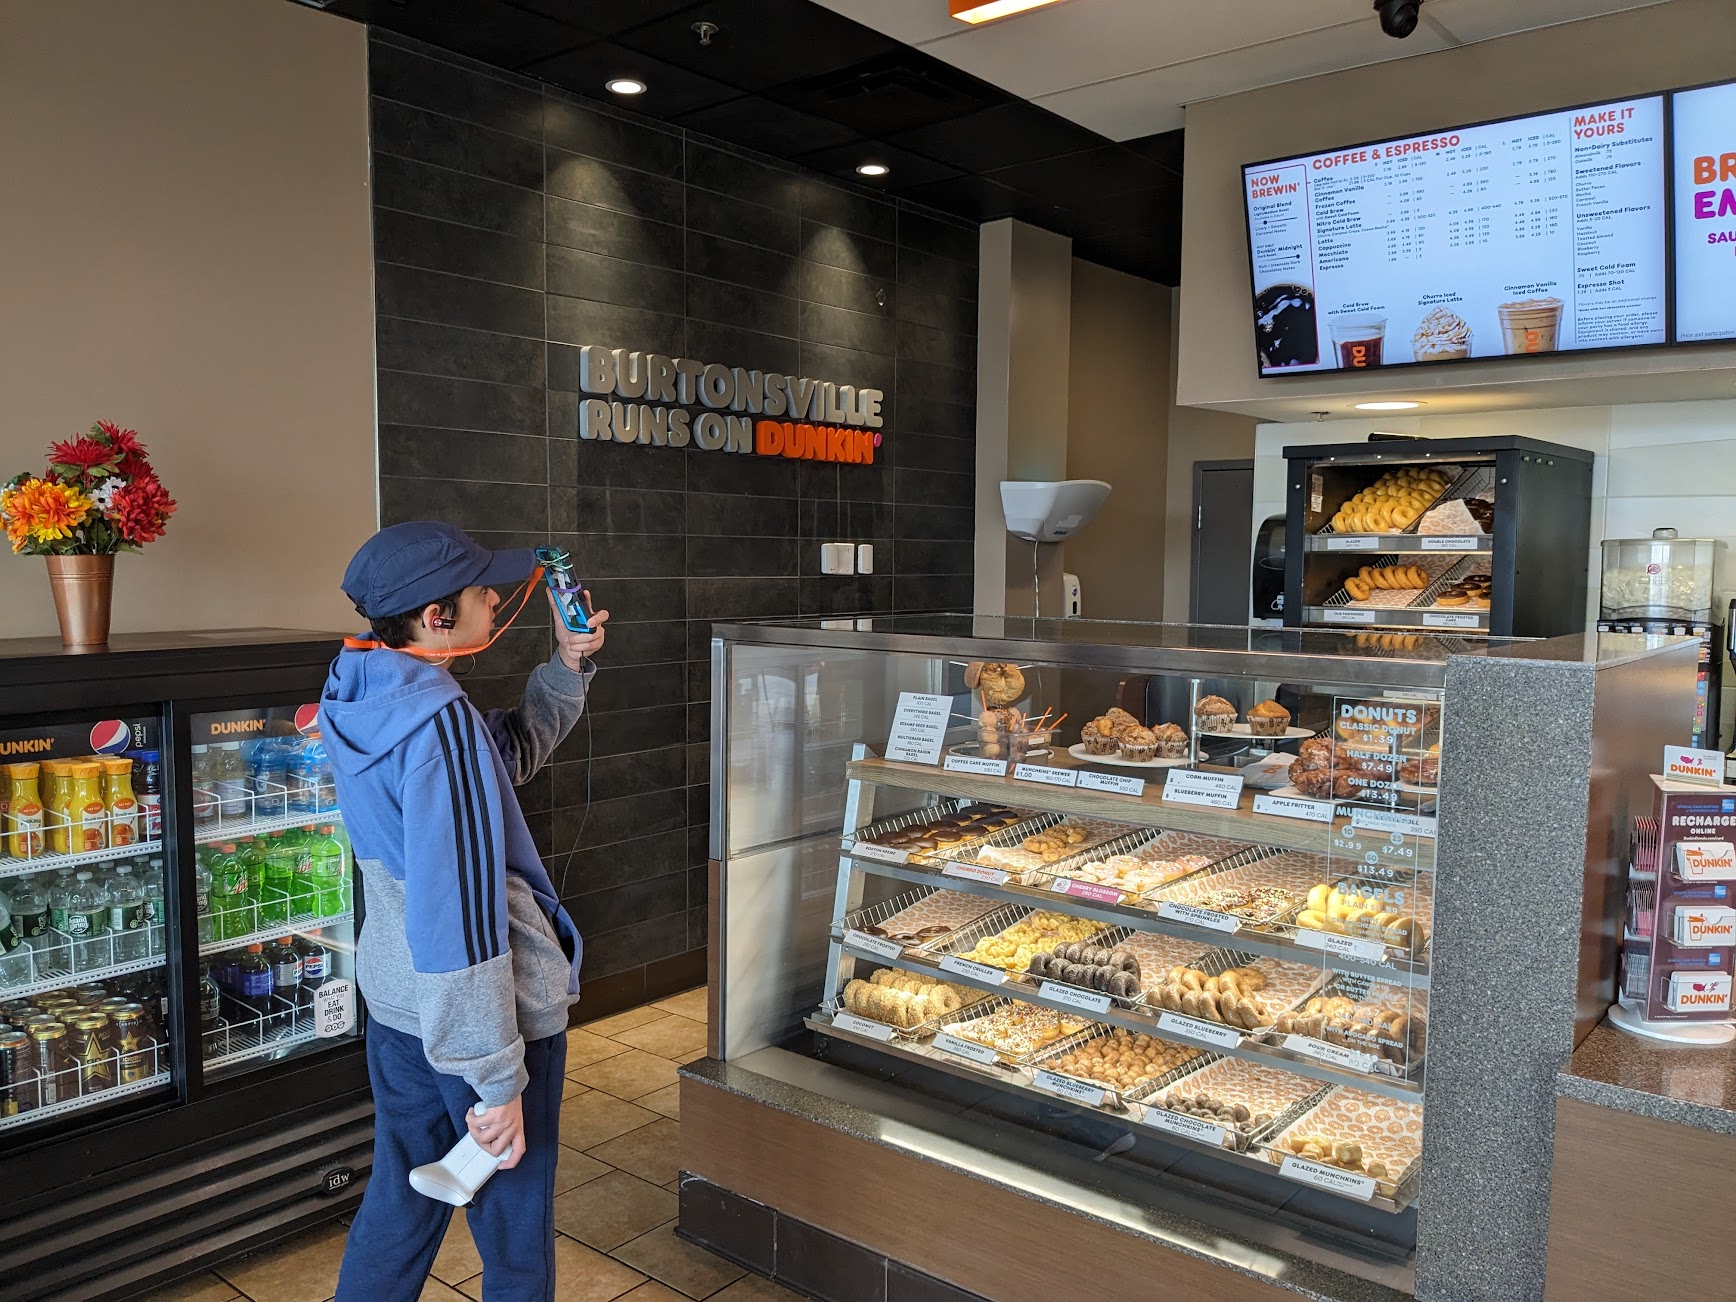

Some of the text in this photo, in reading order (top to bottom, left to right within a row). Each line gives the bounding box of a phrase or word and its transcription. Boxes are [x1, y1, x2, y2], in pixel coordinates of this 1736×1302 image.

[1574, 108, 1634, 127] MAKE IT
[1574, 123, 1624, 140] YOURS
[1612, 137, 1653, 147] Substitutes
[1313, 135, 1460, 170] COFFEE & ESPRESSO
[1576, 161, 1641, 175] Sweetened Flavors
[1251, 174, 1279, 188] NOW
[1252, 182, 1300, 198] BREWIN'
[1253, 202, 1275, 212] Original
[1577, 205, 1650, 218] Unsweetened Flavors
[1577, 281, 1607, 289] Espresso
[1417, 298, 1444, 306] Signature
[580, 346, 884, 428] BURTONSVILLE
[580, 399, 882, 465] RUNS ON DUNKIN'
[1341, 704, 1416, 724] DONUTS
[211, 720, 266, 736] DUNKIN'
[1340, 722, 1416, 735] CLASSIC DONUT
[1362, 734, 1393, 745] $1.39
[1347, 750, 1406, 763] HALF DOZEN
[1362, 762, 1392, 772] $7.49
[1670, 764, 1716, 777] DUNKIN'
[1089, 774, 1120, 782] CHOCOLATE
[1348, 778, 1368, 787] ONE
[1174, 789, 1204, 797] BLUEBERRY
[1360, 790, 1397, 802] $13.49
[1272, 800, 1315, 810] APPLE FRITTER
[1672, 816, 1736, 826] RECHARGE
[1334, 839, 1361, 850] $2.99
[1382, 846, 1412, 857] $7.49
[1693, 858, 1733, 868] DUNKIN'
[976, 868, 995, 876] DONUT
[1358, 865, 1394, 877] $13.49
[1094, 887, 1118, 897] BLOSSOM
[1338, 882, 1404, 906] BAGELS
[1168, 902, 1229, 920] CHOCOLATE FROSTED
[1342, 900, 1367, 910] PLAIN
[1188, 912, 1220, 924] SPRINKLES
[1693, 925, 1733, 934] DUNKIN'
[876, 940, 896, 951] FROSTED
[1327, 937, 1353, 946] GLAZED
[954, 960, 993, 976] FRENCH CRULLER
[1378, 961, 1396, 970] CAL
[1332, 968, 1402, 986] WITH BUTTER SPREAD
[319, 984, 349, 998] BALANCE
[1048, 986, 1101, 1004] GLAZED CHOCOLATE
[328, 999, 340, 1008] EAT
[1681, 994, 1727, 1004] DUNKIN'
[324, 1006, 344, 1016] DRINK
[333, 1013, 342, 1021] DO
[852, 1020, 875, 1030] COCONUT
[1170, 1018, 1227, 1038] GLAZED BLUEBERRY
[1326, 1026, 1403, 1049] WITH AVOCADO SPREAD
[945, 1039, 985, 1055] VANILLA FROSTED
[1307, 1042, 1324, 1052] SOUR
[1326, 1047, 1349, 1058] CREAM
[1046, 1074, 1095, 1093] GLAZED BLUEBERRY
[1156, 1110, 1216, 1132] GLAZED CHOCOLATE
[1292, 1162, 1318, 1174] GLAZED
[329, 1173, 350, 1187] idw
